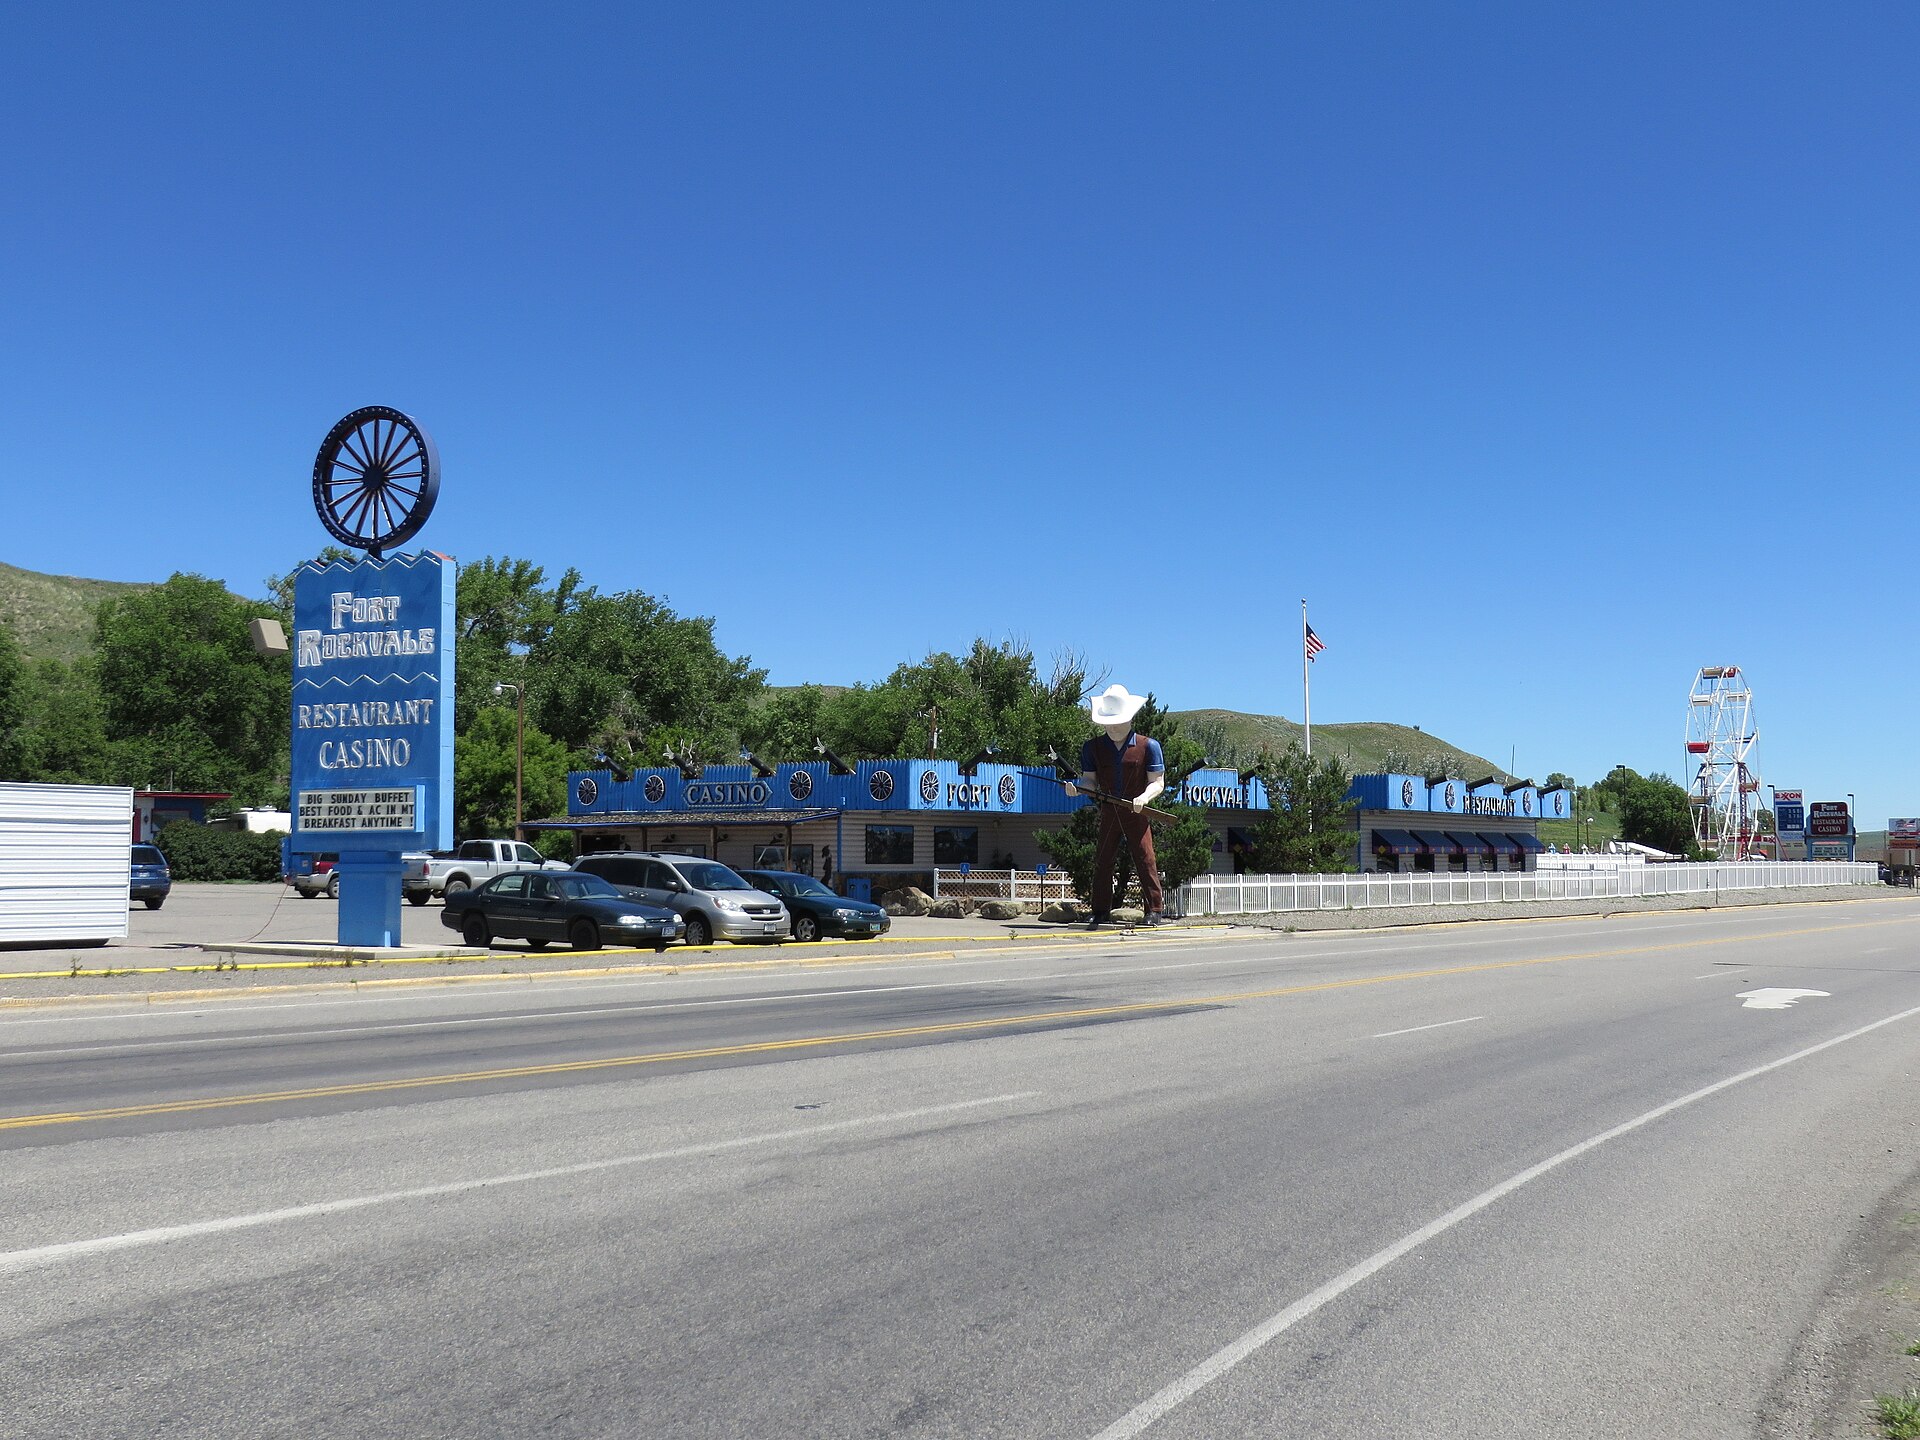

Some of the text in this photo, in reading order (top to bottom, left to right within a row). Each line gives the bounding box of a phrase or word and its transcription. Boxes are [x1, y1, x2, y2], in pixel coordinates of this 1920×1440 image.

[331, 592, 401, 629] FORT
[298, 628, 436, 667] ROCKVALE
[298, 699, 434, 729] RESTAURANT
[319, 738, 411, 770] CASINO
[307, 791, 410, 805] BIG SUNDAY BUFFET
[687, 784, 766, 804] CASINO
[947, 783, 993, 803] FORT
[1183, 784, 1249, 805] ROCKVALE
[1775, 792, 1802, 801] EXXON
[299, 803, 415, 817] BEST FOOD & AC IN MT
[1464, 795, 1517, 813] RESTAURANT
[304, 817, 356, 829] BREAKFAST
[361, 816, 403, 828] ANYTIME
